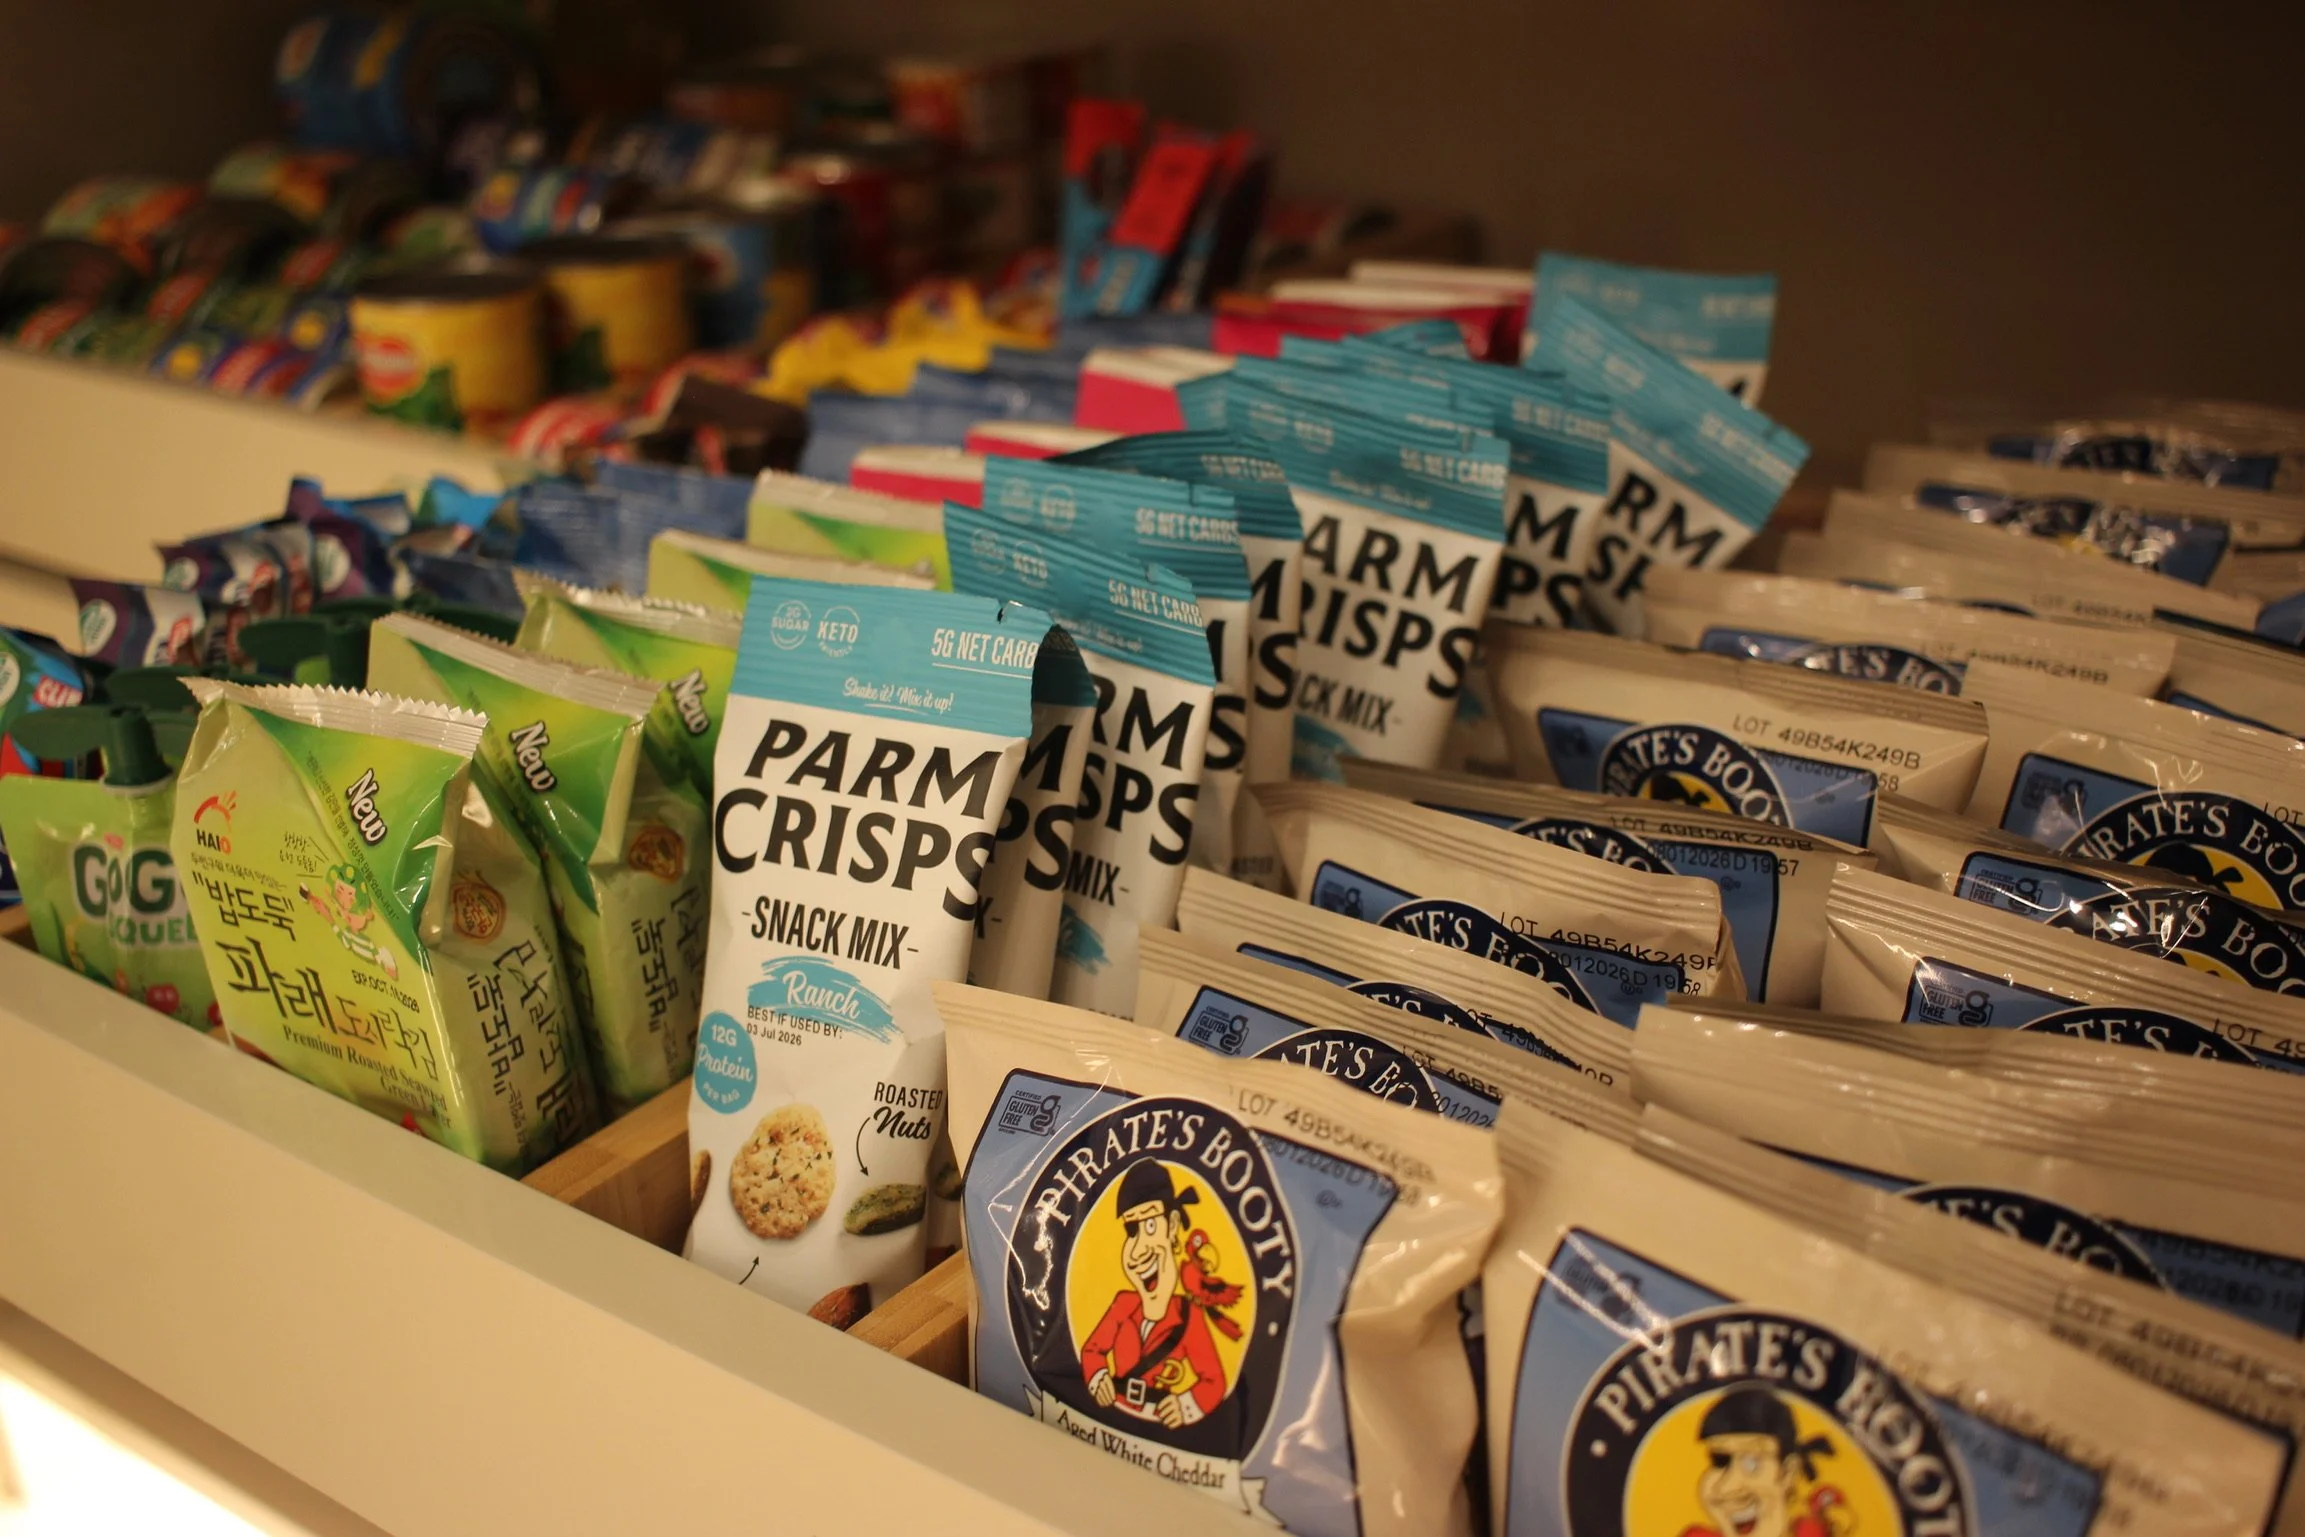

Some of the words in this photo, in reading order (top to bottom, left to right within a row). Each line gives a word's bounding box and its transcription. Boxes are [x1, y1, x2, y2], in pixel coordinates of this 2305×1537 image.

[1607, 471, 1727, 569] RM
[1303, 514, 1481, 613] ARM
[816, 619, 859, 644] KETO
[1160, 595, 1203, 629] CARB
[931, 627, 955, 658] 5G
[957, 633, 992, 663] NET
[992, 636, 1039, 670] CARB
[671, 669, 710, 735] New
[1091, 673, 1196, 772] RM
[1732, 713, 1772, 738] LOT
[510, 721, 557, 792] New
[744, 719, 1004, 820] PARM
[346, 768, 388, 846] New
[1074, 752, 1200, 866] SPS
[1701, 745, 1781, 828] BOO
[714, 787, 996, 921] CRISPS
[2078, 800, 2230, 861] RATE'S
[783, 969, 862, 1020] Ranch
[710, 1023, 738, 1047] 12G
[746, 1022, 758, 1036] 03
[760, 1026, 776, 1041] Jul
[778, 1030, 802, 1046] 2026
[747, 1004, 775, 1022] BEST
[777, 1012, 788, 1026] IF
[790, 1015, 821, 1034] USED
[822, 1024, 843, 1040] BY:
[282, 1023, 344, 1060] Premium
[346, 1043, 399, 1081] Roasted
[696, 1042, 755, 1083] Protein
[1282, 1039, 1374, 1081] TE'S
[873, 1105, 932, 1140] Nuts
[874, 1081, 944, 1111] ROASTED
[1002, 1112, 1023, 1127] FREE
[1009, 1100, 1040, 1117] GLUTEN
[1238, 1087, 1278, 1117] LOT
[1036, 1109, 1206, 1227] PIRATE'S
[1201, 1127, 1295, 1300] BOOTY
[1056, 1408, 1098, 1447] Aged
[1100, 1429, 1154, 1472] White
[1156, 1451, 1227, 1490] Cheddar
[1595, 1318, 1838, 1438] PIRATE'S
[1836, 1366, 1965, 1537] BOO
